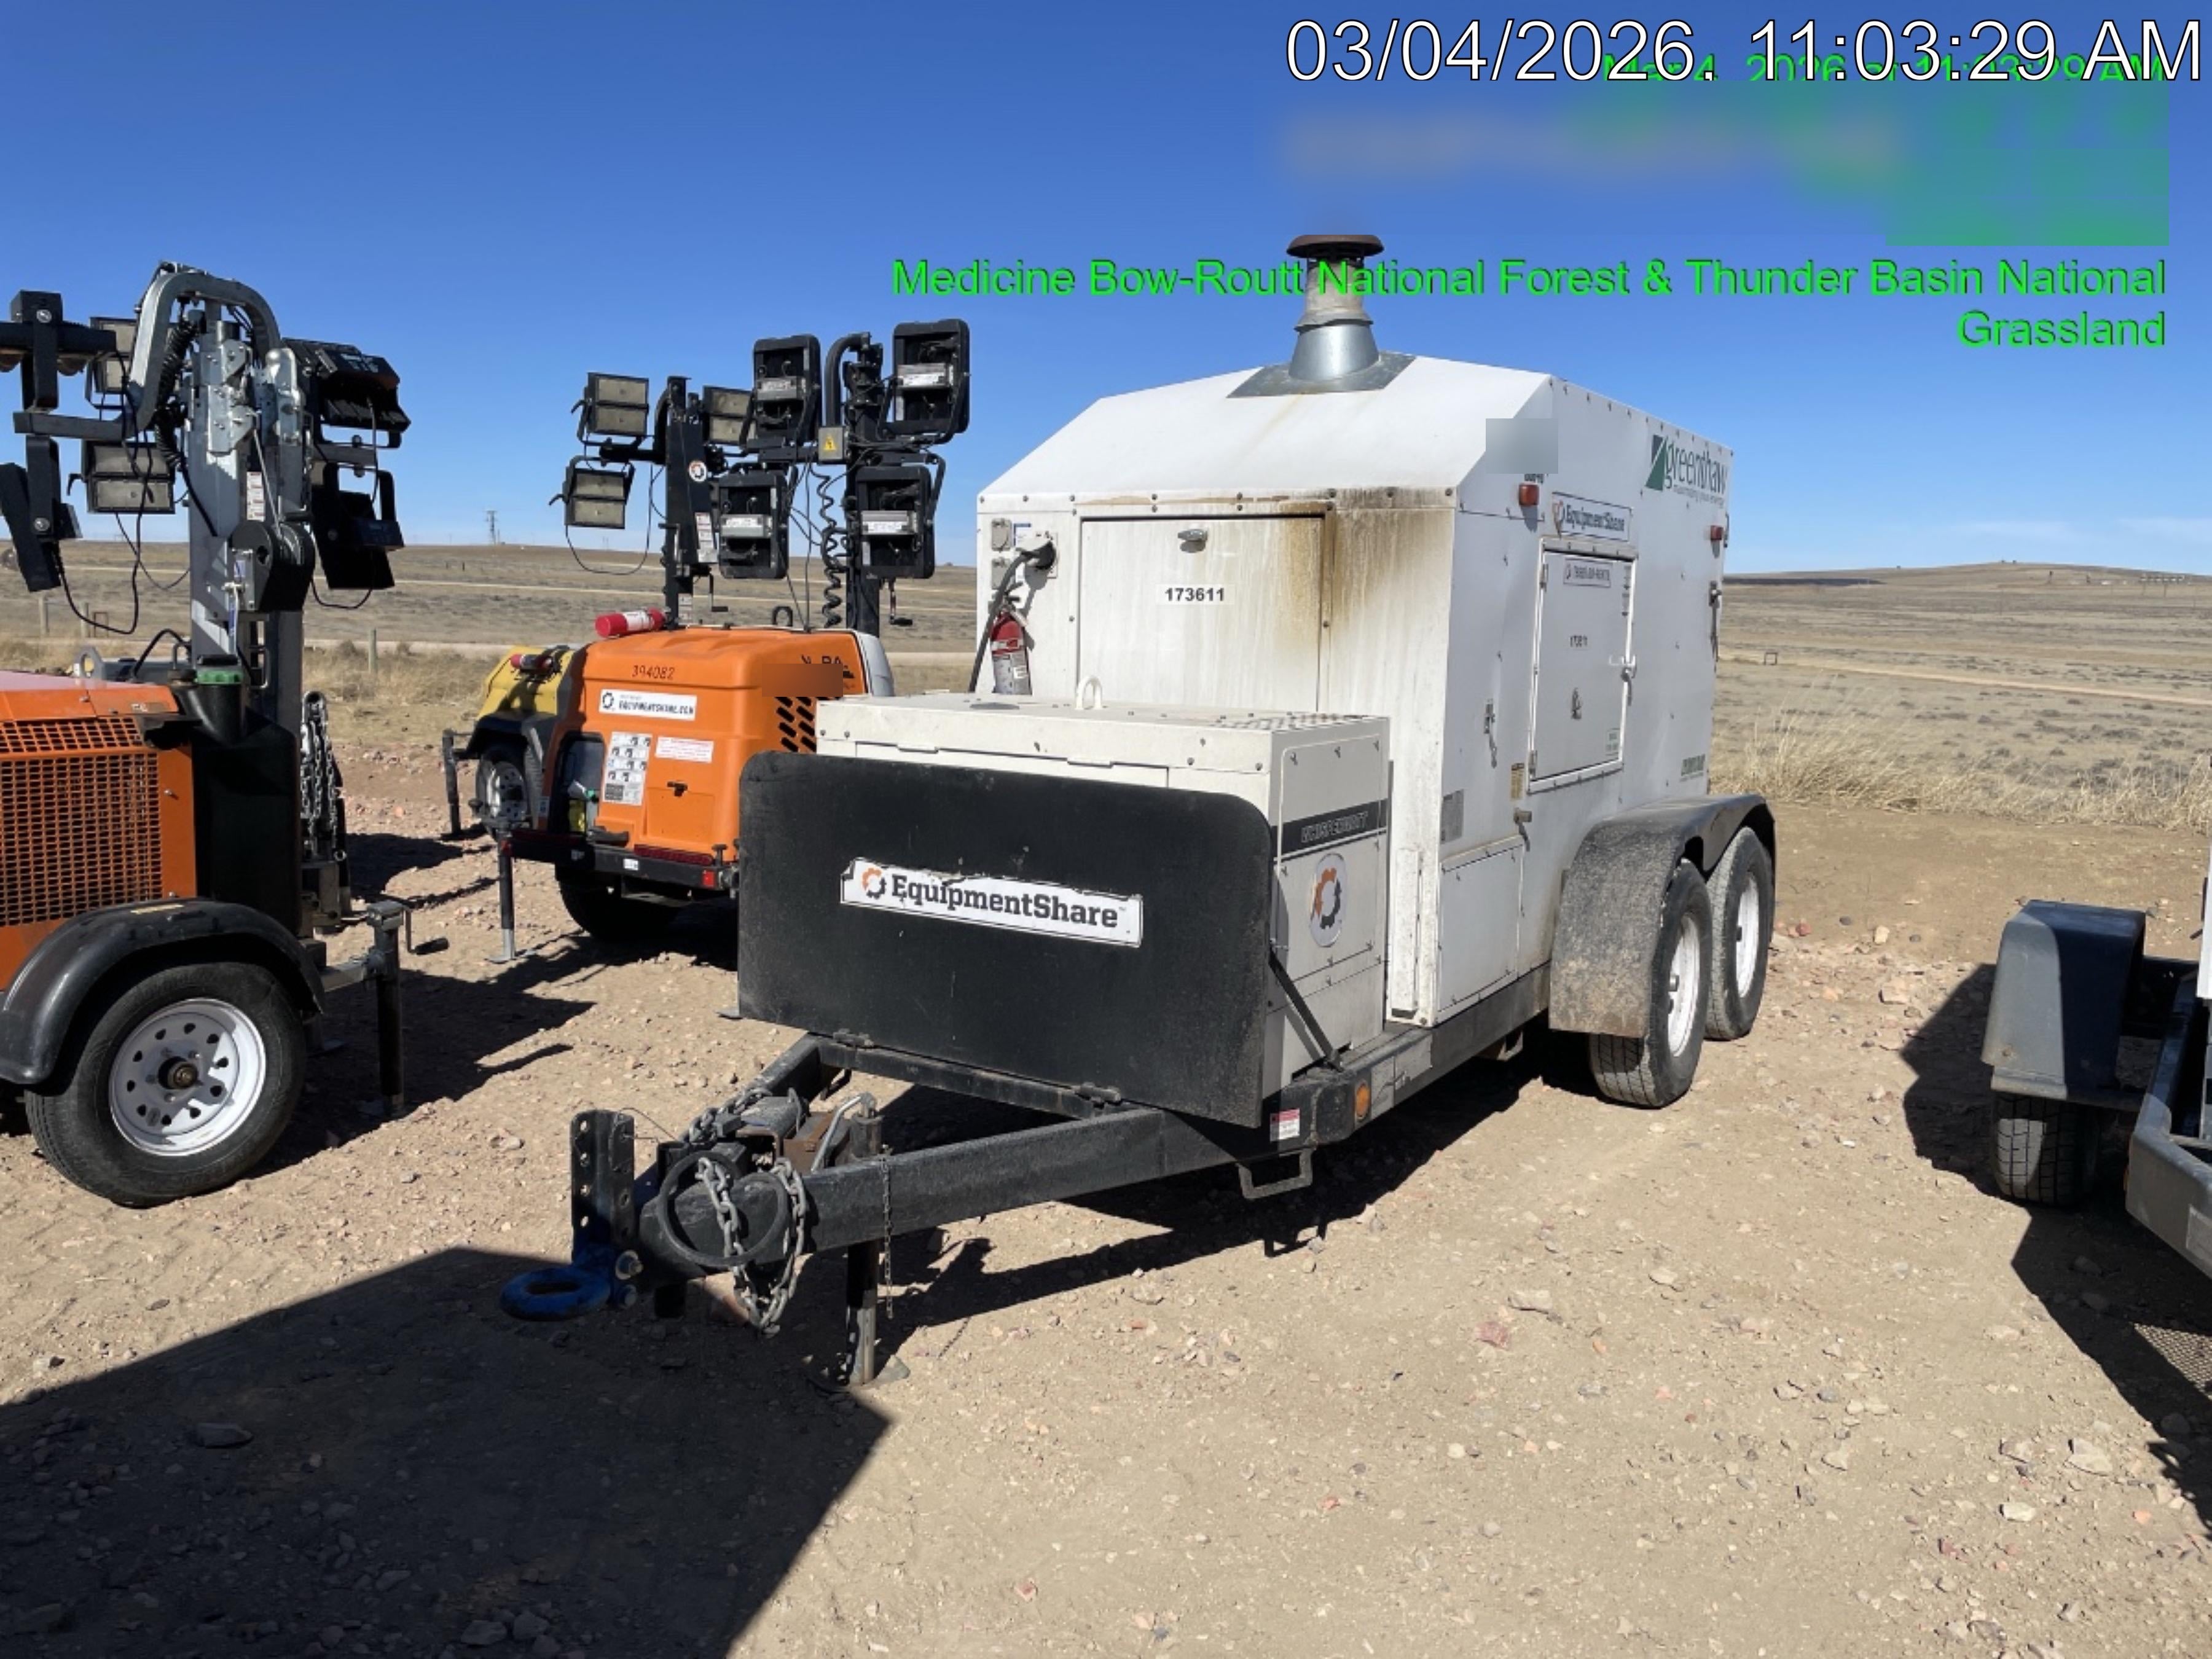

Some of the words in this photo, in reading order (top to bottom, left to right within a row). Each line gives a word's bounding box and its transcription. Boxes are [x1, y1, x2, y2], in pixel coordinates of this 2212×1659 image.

[1164, 587, 1225, 602] 173611
[632, 665, 675, 680] 394082
[891, 874, 1118, 928] EquipmentShare
